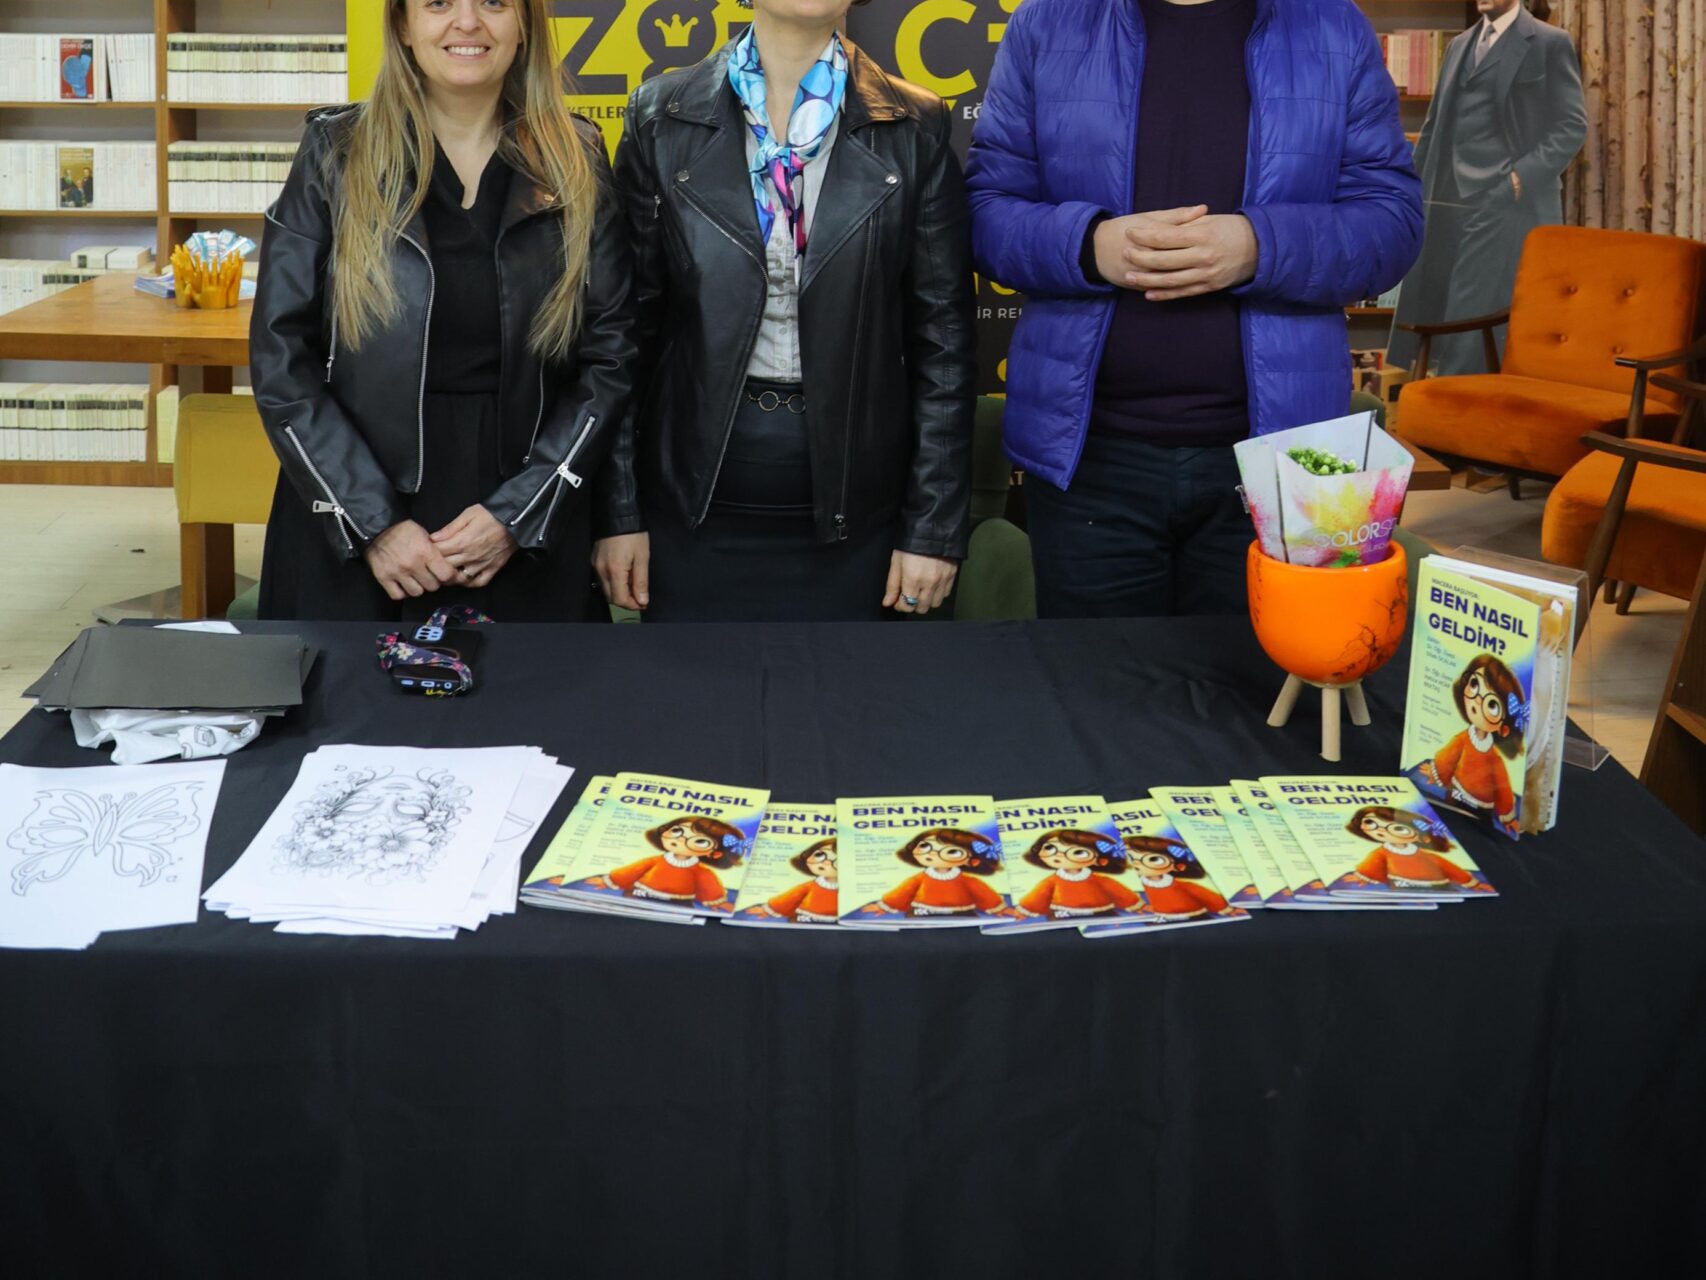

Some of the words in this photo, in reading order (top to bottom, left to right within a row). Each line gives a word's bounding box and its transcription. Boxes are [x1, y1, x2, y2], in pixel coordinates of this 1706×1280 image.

[1430, 586, 1468, 614] BEN
[1473, 602, 1529, 638] NASIL
[1428, 612, 1506, 656] GELDİM?
[625, 782, 677, 797] BEN
[682, 790, 755, 807] NASIL
[1279, 784, 1332, 793] BEN
[1336, 785, 1409, 794] NASIL
[619, 795, 724, 817] GELDİM?
[1288, 795, 1389, 805] GELDİM?
[852, 806, 905, 816] BEN
[911, 805, 986, 815] NASIL
[995, 809, 1021, 820] EN
[1027, 805, 1102, 817] NASIL
[1111, 810, 1162, 823] ASIL
[853, 816, 960, 829] GELDİM?
[998, 819, 1079, 833] ELDİM?
